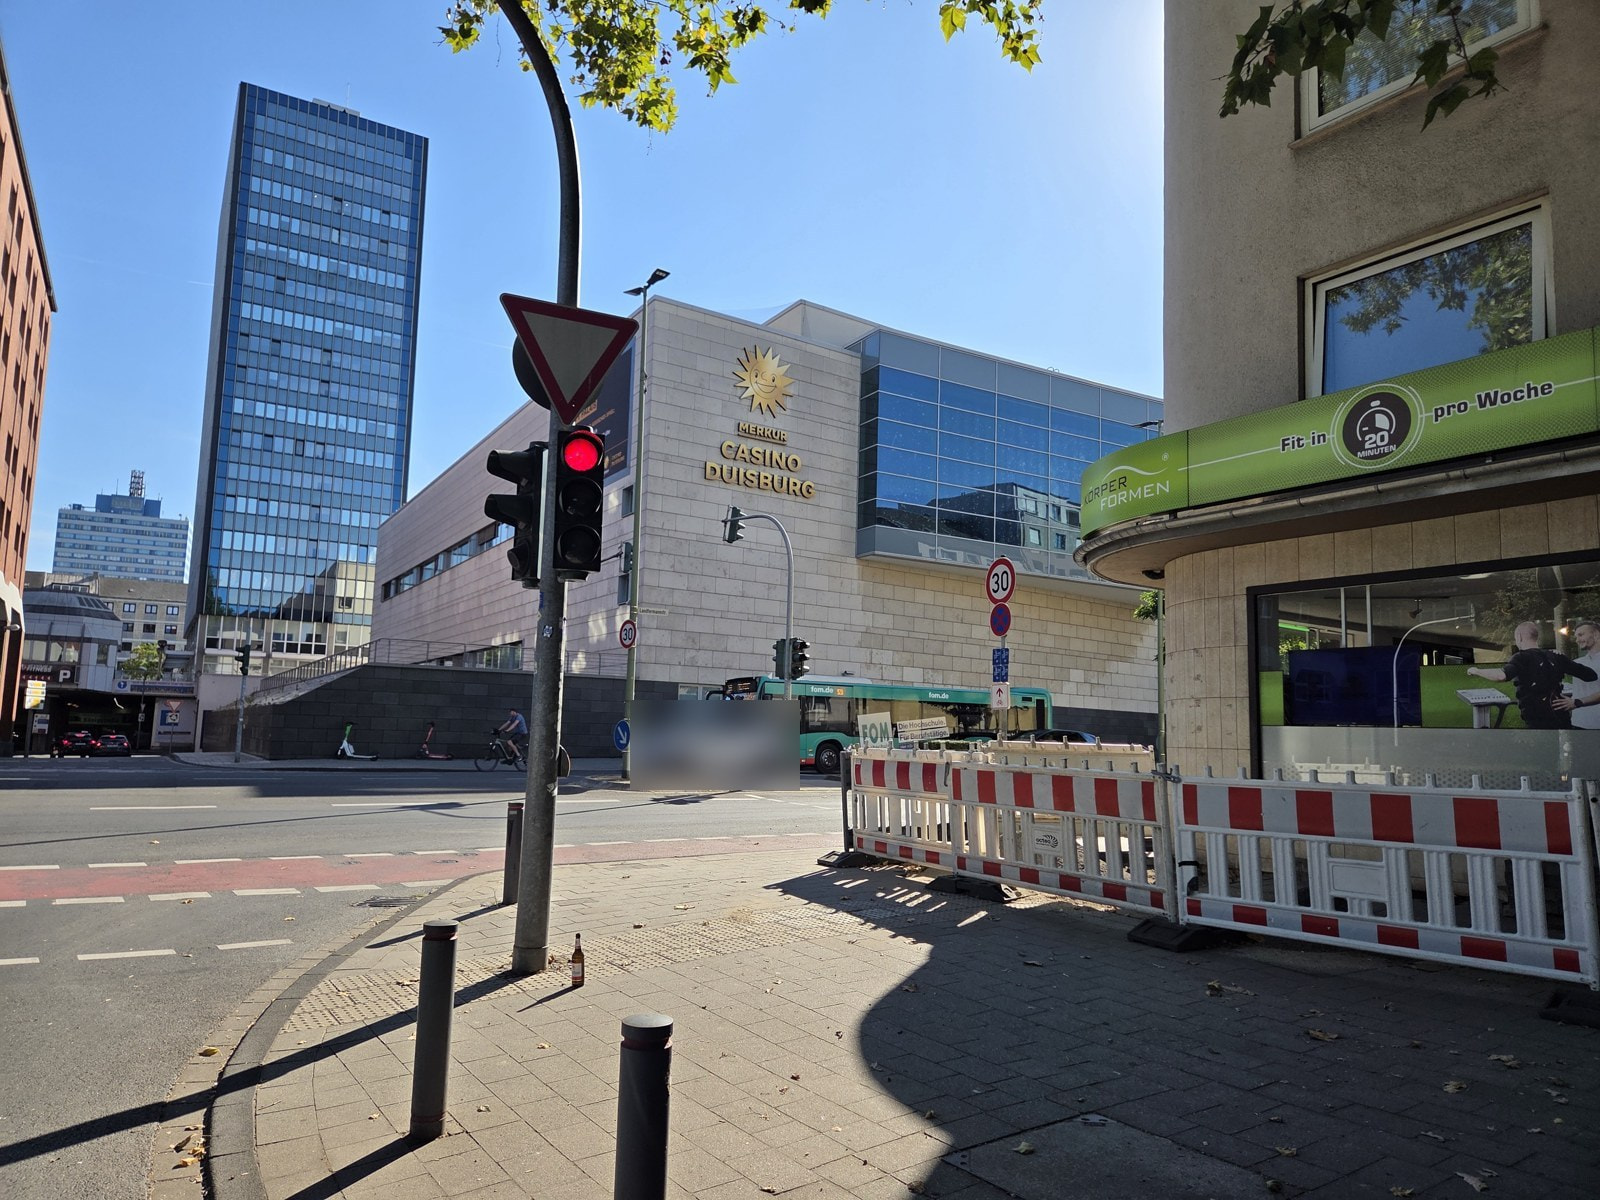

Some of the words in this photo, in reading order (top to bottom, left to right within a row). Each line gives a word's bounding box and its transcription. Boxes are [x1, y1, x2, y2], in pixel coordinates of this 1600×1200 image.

[1433, 400, 1469, 423] pro
[1476, 382, 1554, 411] Woche
[739, 422, 788, 441] MERKUR
[1364, 431, 1390, 450] 20
[1281, 436, 1305, 453] Fit
[1311, 431, 1328, 447] in
[1356, 444, 1397, 459] MINUTEN
[721, 440, 802, 472] CASINO
[705, 461, 816, 498] DUISBURG
[1100, 480, 1170, 511] FORMEN
[991, 570, 1009, 594] 30
[623, 627, 633, 641] 30
[59, 670, 71, 682] P
[810, 685, 834, 694] fom.de
[928, 691, 949, 699] fom.de
[861, 721, 889, 744] FOM
[898, 722, 908, 730] Die
[909, 719, 946, 729] Hochschule.
